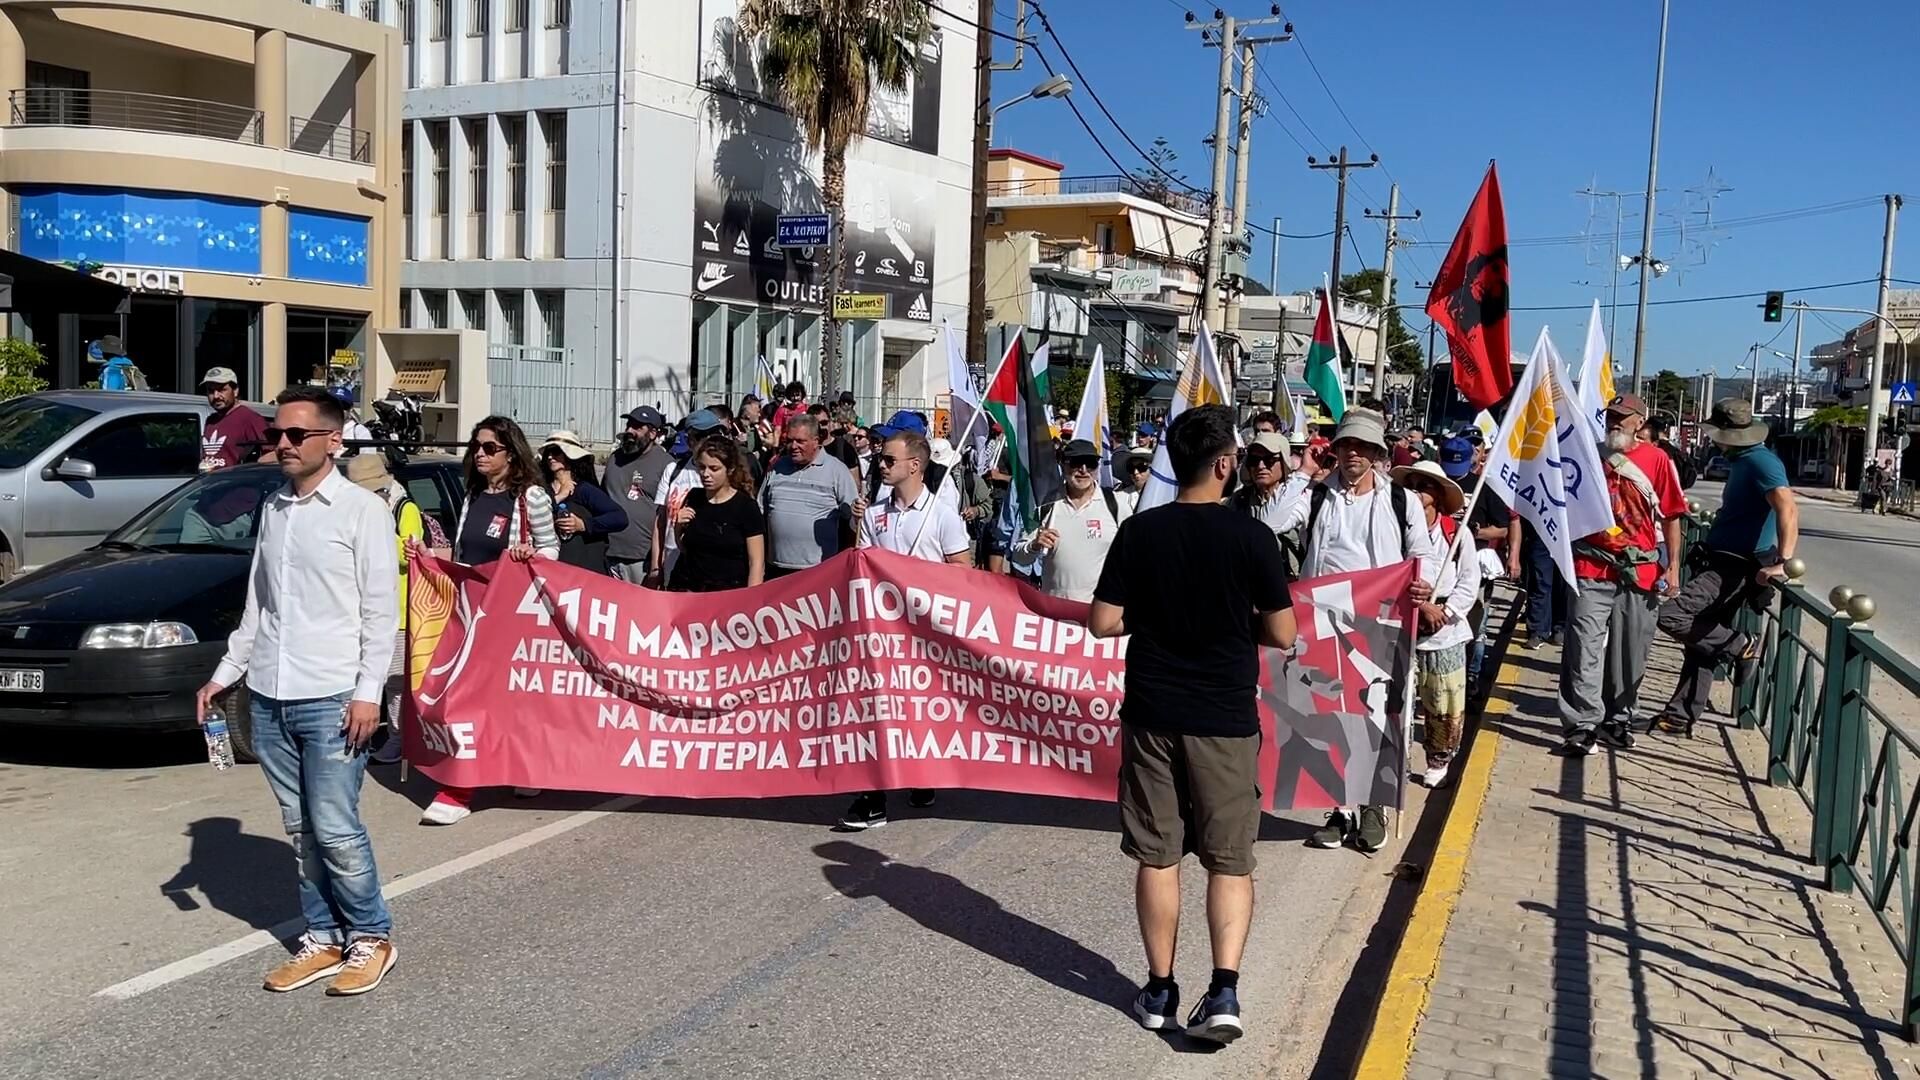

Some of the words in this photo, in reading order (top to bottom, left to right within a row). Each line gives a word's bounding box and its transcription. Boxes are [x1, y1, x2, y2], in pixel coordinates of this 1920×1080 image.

[703, 262, 728, 280] NIKE
[765, 279, 826, 304] OUTLET
[835, 296, 853, 310] Fast
[628, 587, 843, 660] ΜΑΡΑΘΩΝΙΑ
[849, 578, 1000, 645] ΠΟΡΕΙΑ
[511, 637, 658, 690] ΑΠΕΜΠΟΚΗ
[663, 668, 711, 692] ΤΗΣ
[715, 644, 816, 691] ΕΛΛΑΔΑΣ
[817, 637, 851, 668] ΑΠΟ
[854, 631, 905, 659] ΤΟΥΣ
[911, 636, 1038, 687] ΠΟΛΕΜΟΥΣ
[1042, 663, 1125, 693] ΗΠΑ-Ν
[508, 667, 545, 693] ΝΑ
[718, 675, 813, 711] ΦΡΕΓΑΤΑ
[818, 665, 885, 697] «ΥΔΡΑ»
[890, 664, 932, 690] ΑΠΟ
[938, 667, 984, 699] ΤΗΝ
[991, 682, 1082, 718] ΕΡΥΘΡΑ
[1089, 697, 1121, 721] ΘΑ
[597, 703, 640, 731] ΝΑ
[649, 706, 791, 735] ΚΛΕΙΣΟΥΝ
[797, 704, 823, 731] ΟΙ
[827, 695, 905, 727] ΒΑΣΕΙΣ
[911, 696, 969, 723] ΤΟΥ
[977, 703, 1121, 747] ΘΑΝΑΤΟΥ
[620, 737, 790, 771] ΛΕΥΤΕΡΙΑ
[797, 729, 878, 769] ΣΤΗΝ
[886, 728, 1093, 775] ΠΑΛΑΙΣΤΙΝΗ
